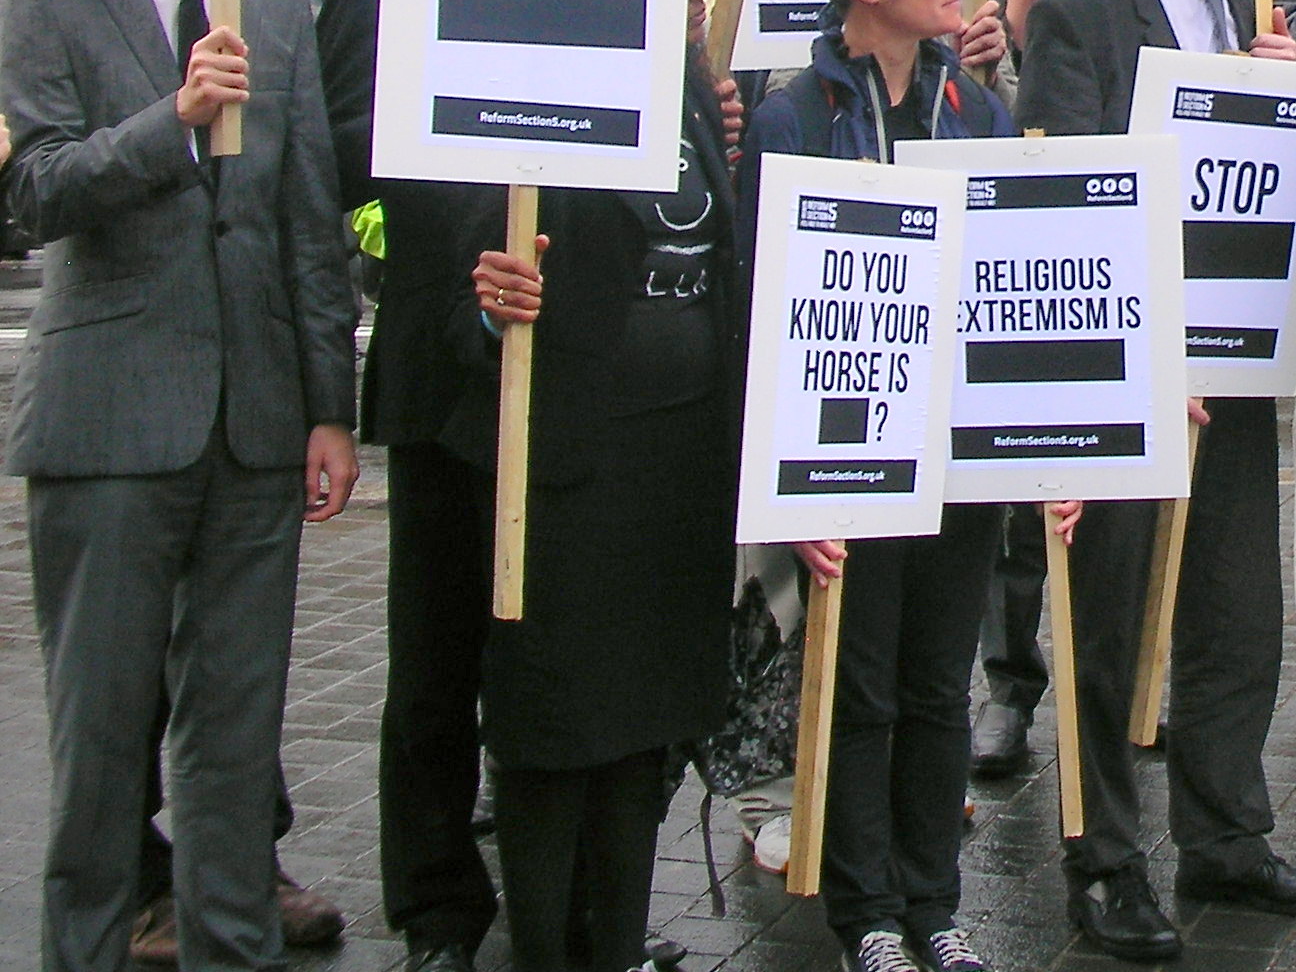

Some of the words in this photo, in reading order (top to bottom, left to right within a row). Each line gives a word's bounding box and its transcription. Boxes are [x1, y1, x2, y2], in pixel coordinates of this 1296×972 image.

[480, 111, 592, 131] ReformSection5.org.uk
[1191, 158, 1279, 215] STOP
[823, 250, 853, 291] DO
[863, 252, 907, 294] YOU
[976, 258, 1111, 292] RELIGIOUS
[790, 298, 863, 341] KNOW
[871, 302, 929, 344] YOUR
[1118, 297, 1140, 328] IS
[804, 350, 882, 392] HORSE
[888, 353, 909, 392] IS
[875, 402, 888, 441] ?
[994, 435, 1099, 448] ReformSection5.org.uk
